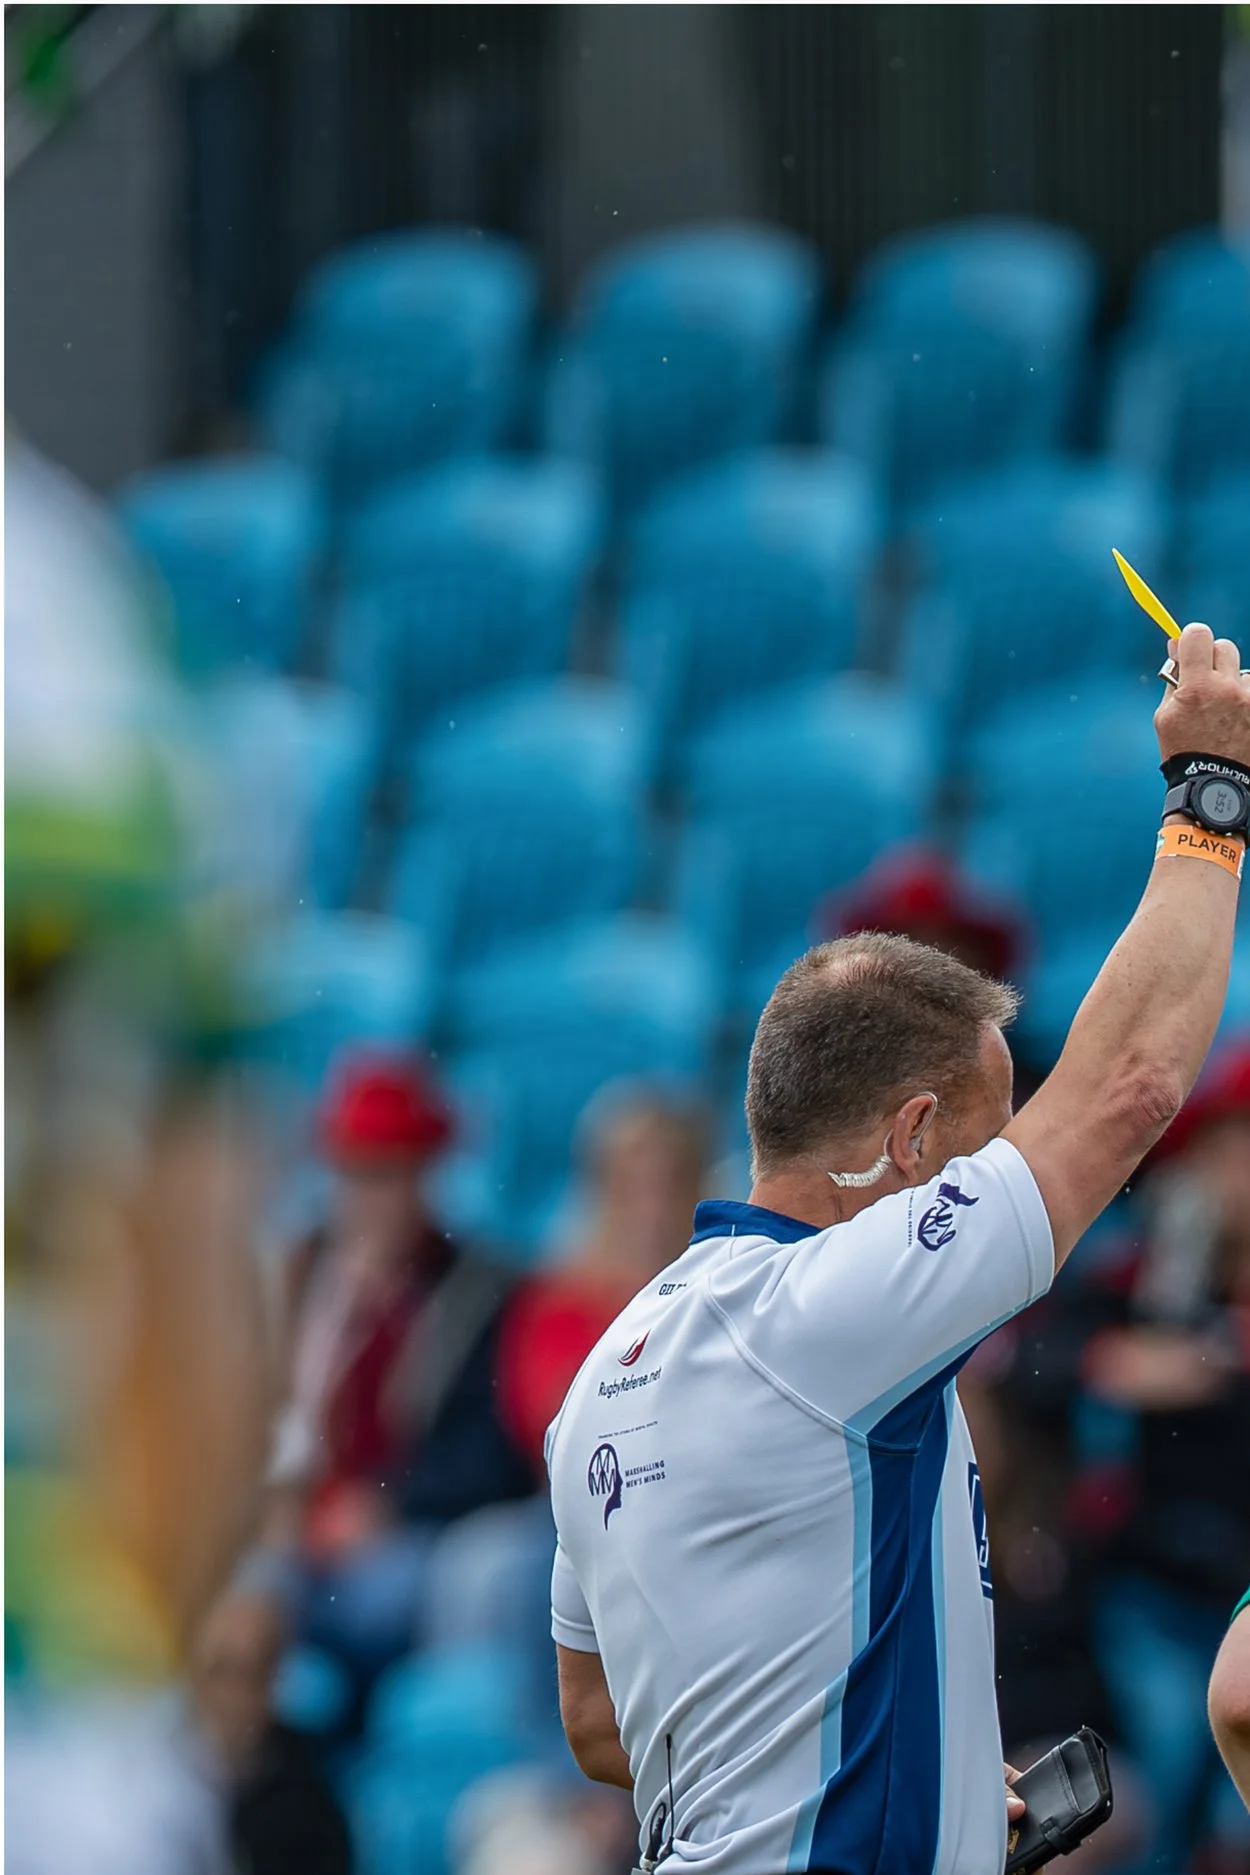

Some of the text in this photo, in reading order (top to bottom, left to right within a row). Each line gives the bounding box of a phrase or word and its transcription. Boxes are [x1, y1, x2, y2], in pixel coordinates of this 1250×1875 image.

[1177, 834, 1236, 863] PLAYER
[598, 1366, 662, 1399] RugbyReferee.net
[625, 1460, 665, 1477] MARSHALLING
[626, 1471, 666, 1488] MEN'S MINDS
